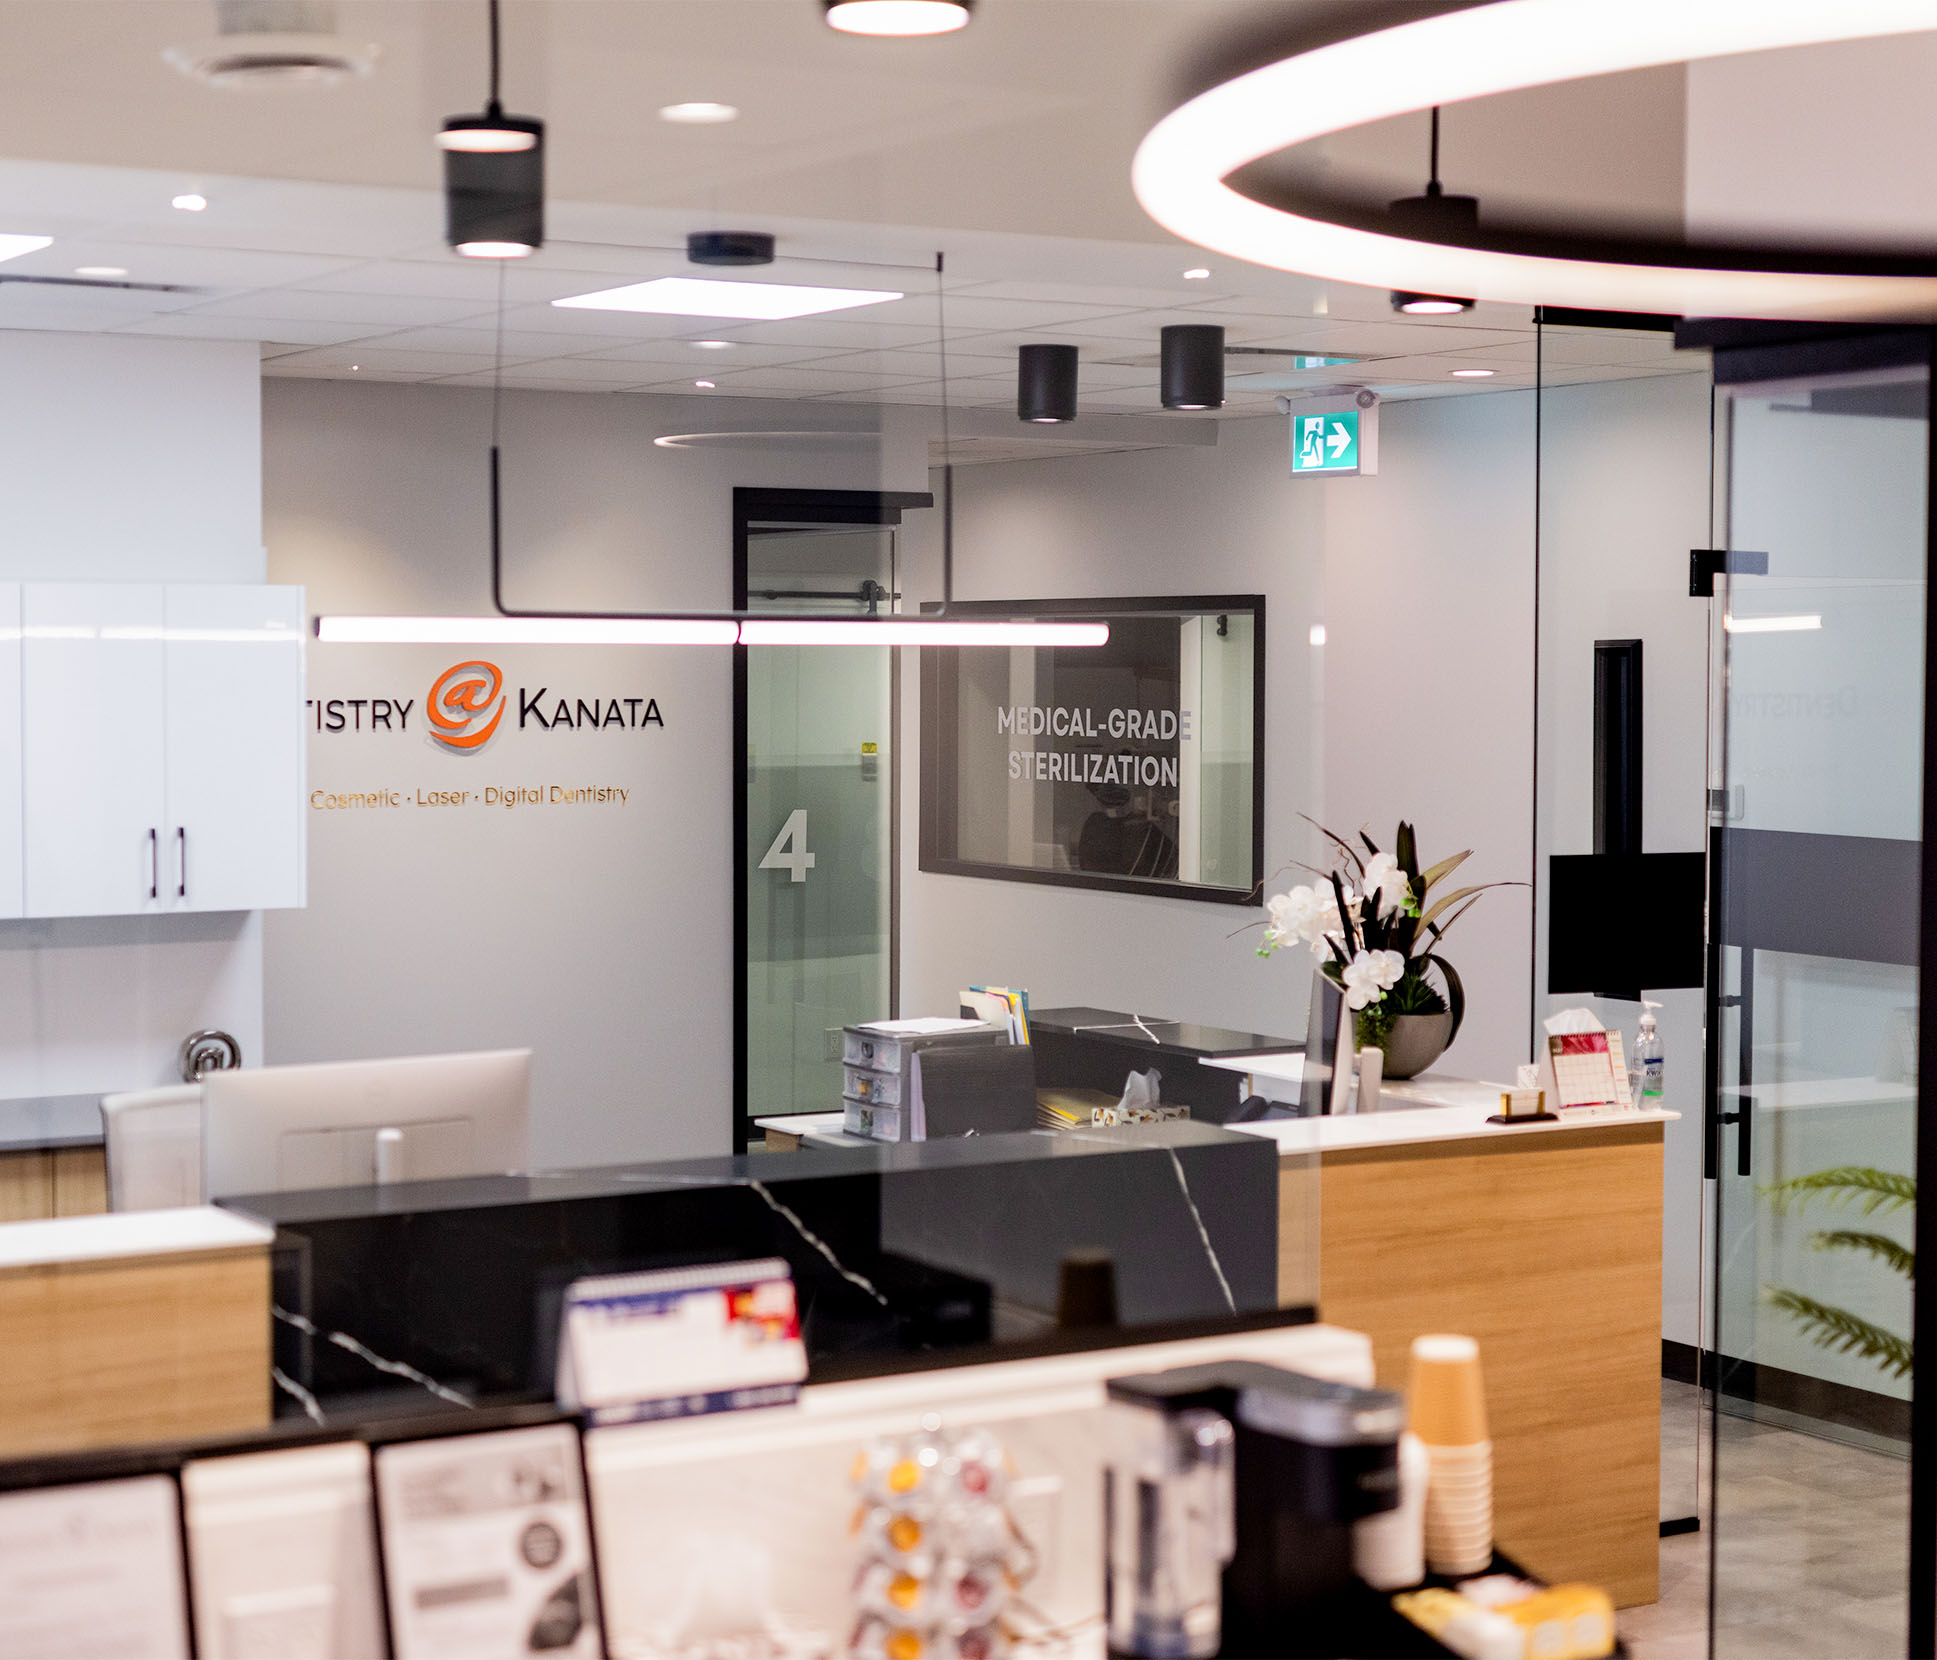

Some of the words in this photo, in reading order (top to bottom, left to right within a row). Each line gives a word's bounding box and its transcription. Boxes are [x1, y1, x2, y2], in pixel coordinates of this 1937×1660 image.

[306, 699, 414, 730] ISTRY
[519, 687, 665, 728] KANATA
[997, 706, 1192, 741] MEDICAL-GRADE
[1008, 750, 1178, 787] STERILIZATION
[310, 789, 401, 809] Cosmetic
[416, 787, 470, 806] Laser
[484, 785, 544, 808] Digital
[550, 785, 630, 804] Dentistry
[758, 809, 815, 882] 4
